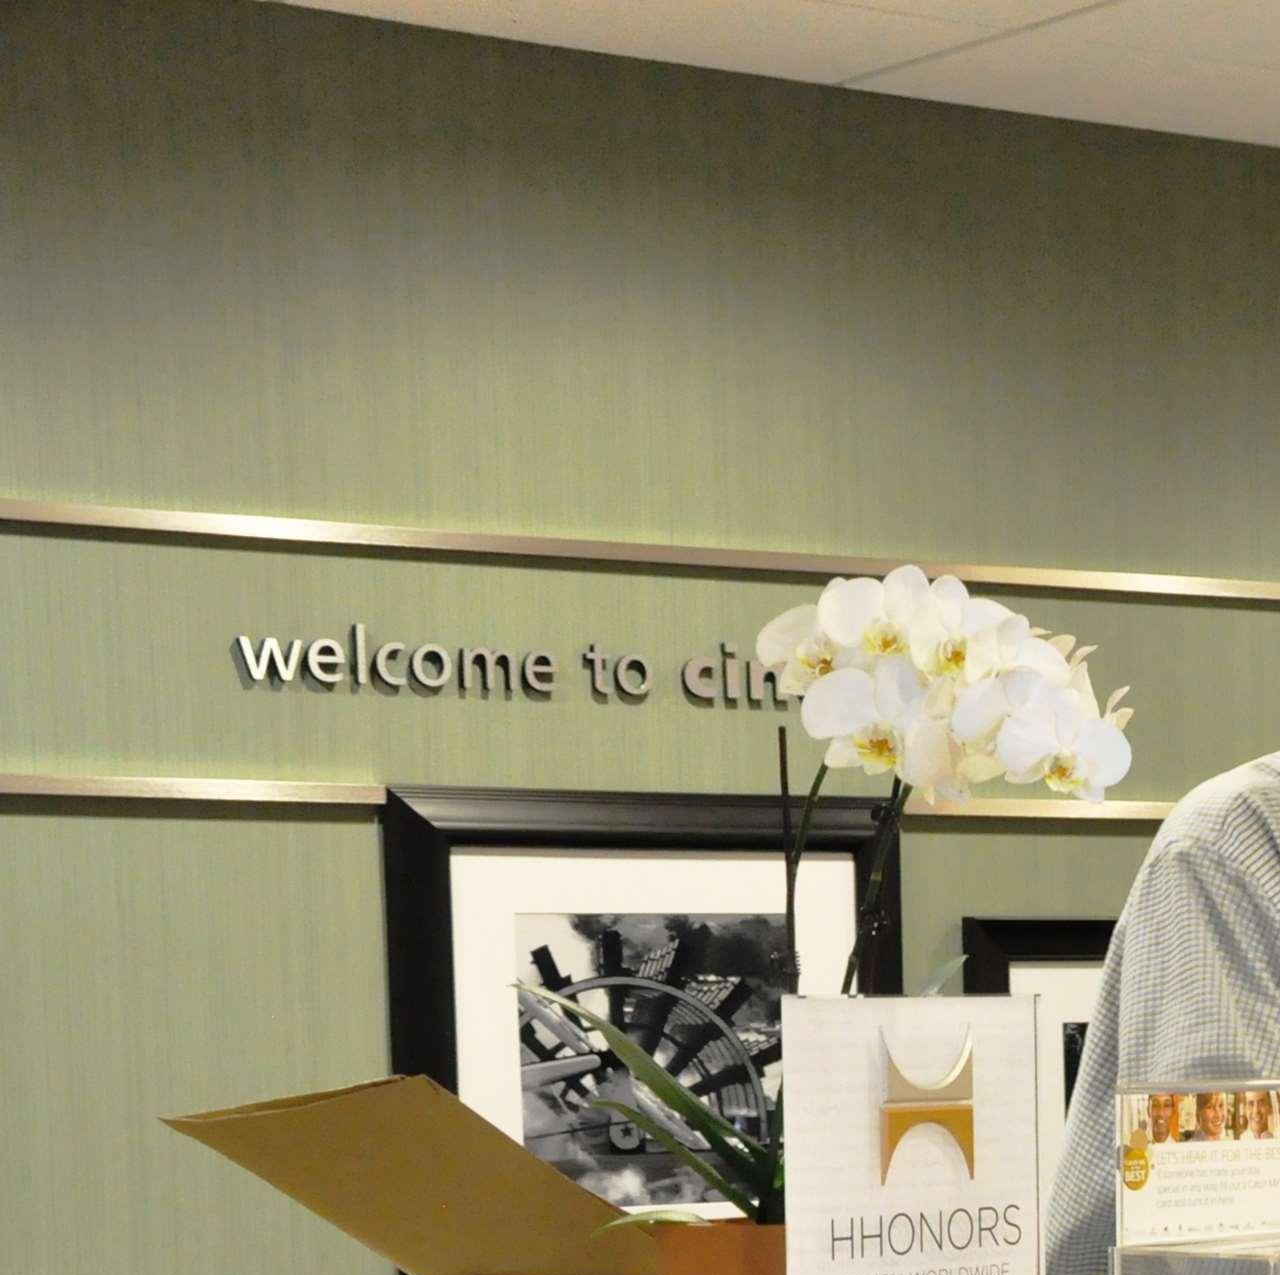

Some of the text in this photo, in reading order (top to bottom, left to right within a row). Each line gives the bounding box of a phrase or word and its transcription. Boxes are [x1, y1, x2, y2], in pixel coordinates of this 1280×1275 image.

[237, 623, 805, 703] welcome to cin
[831, 1204, 1023, 1261] HHONORS
